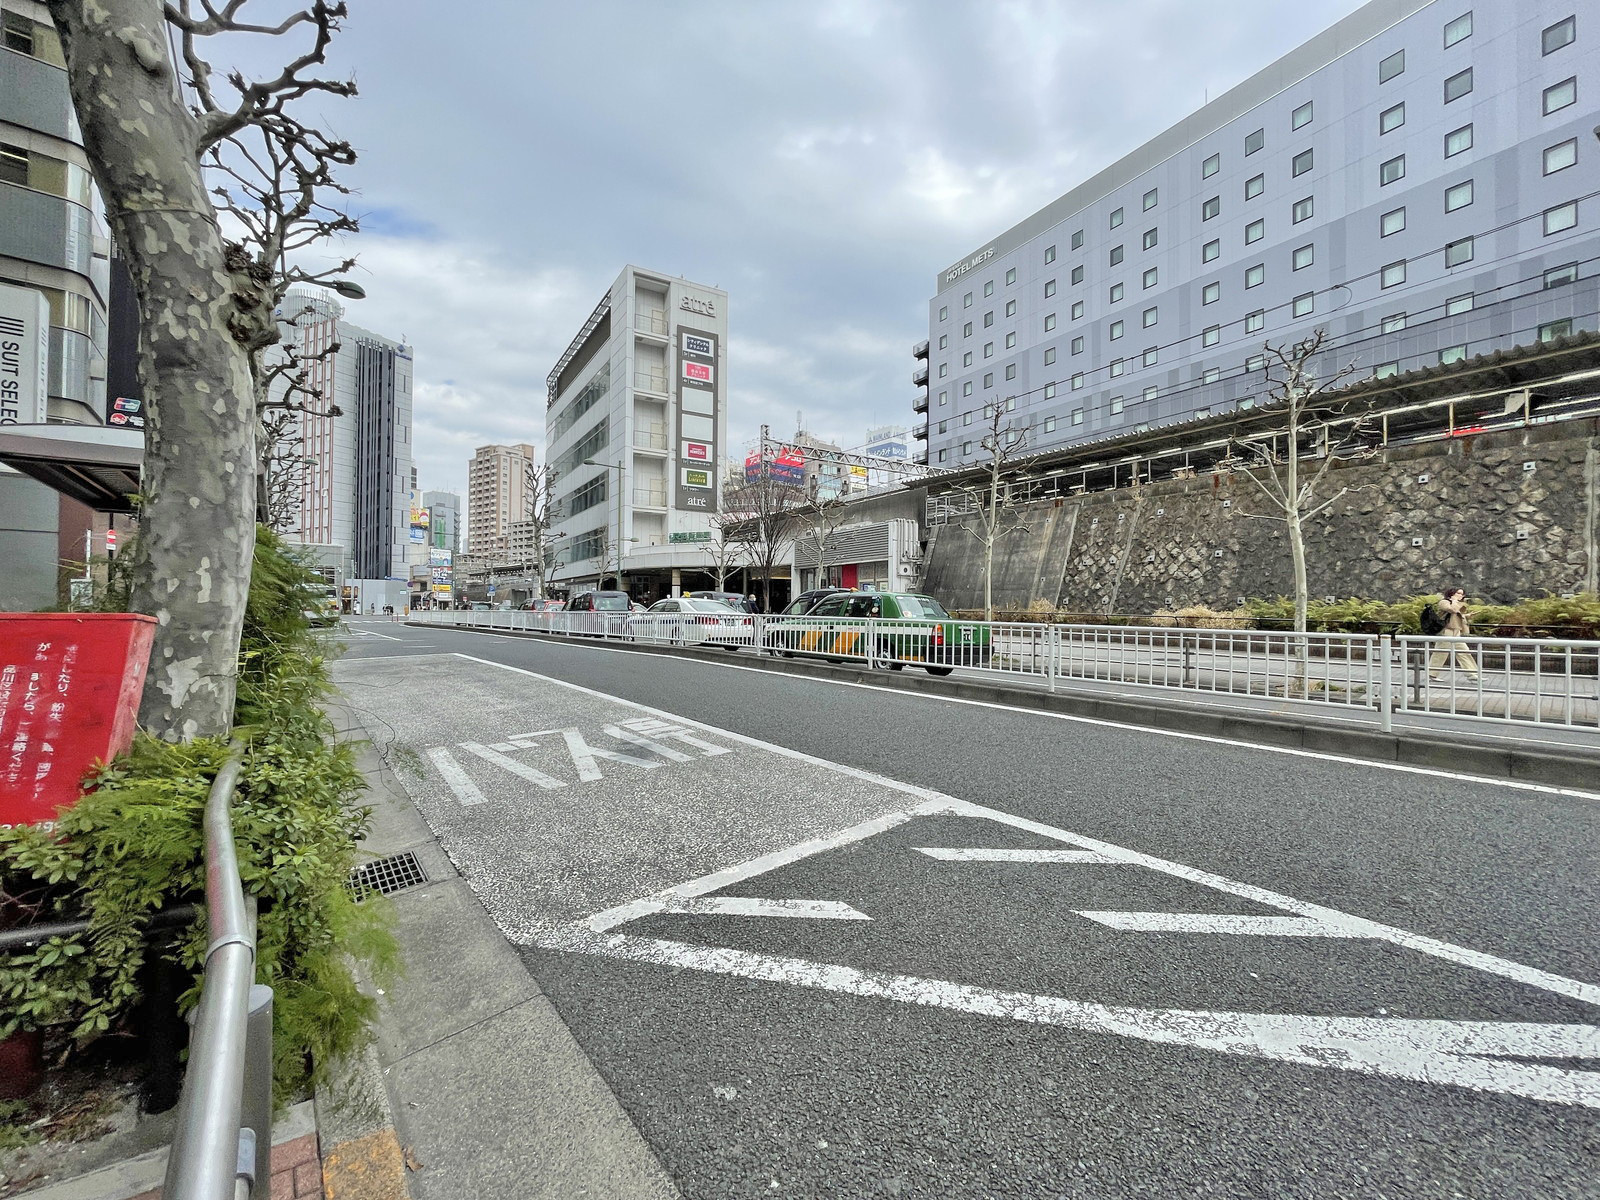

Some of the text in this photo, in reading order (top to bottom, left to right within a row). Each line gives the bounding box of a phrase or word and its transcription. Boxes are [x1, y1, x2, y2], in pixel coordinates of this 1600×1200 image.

[946, 247, 995, 283] HOTEL METS
[681, 295, 716, 316] atré
[1, 341, 20, 377] SUIT
[687, 496, 707, 506] atré
[425, 717, 732, 806] バス停
